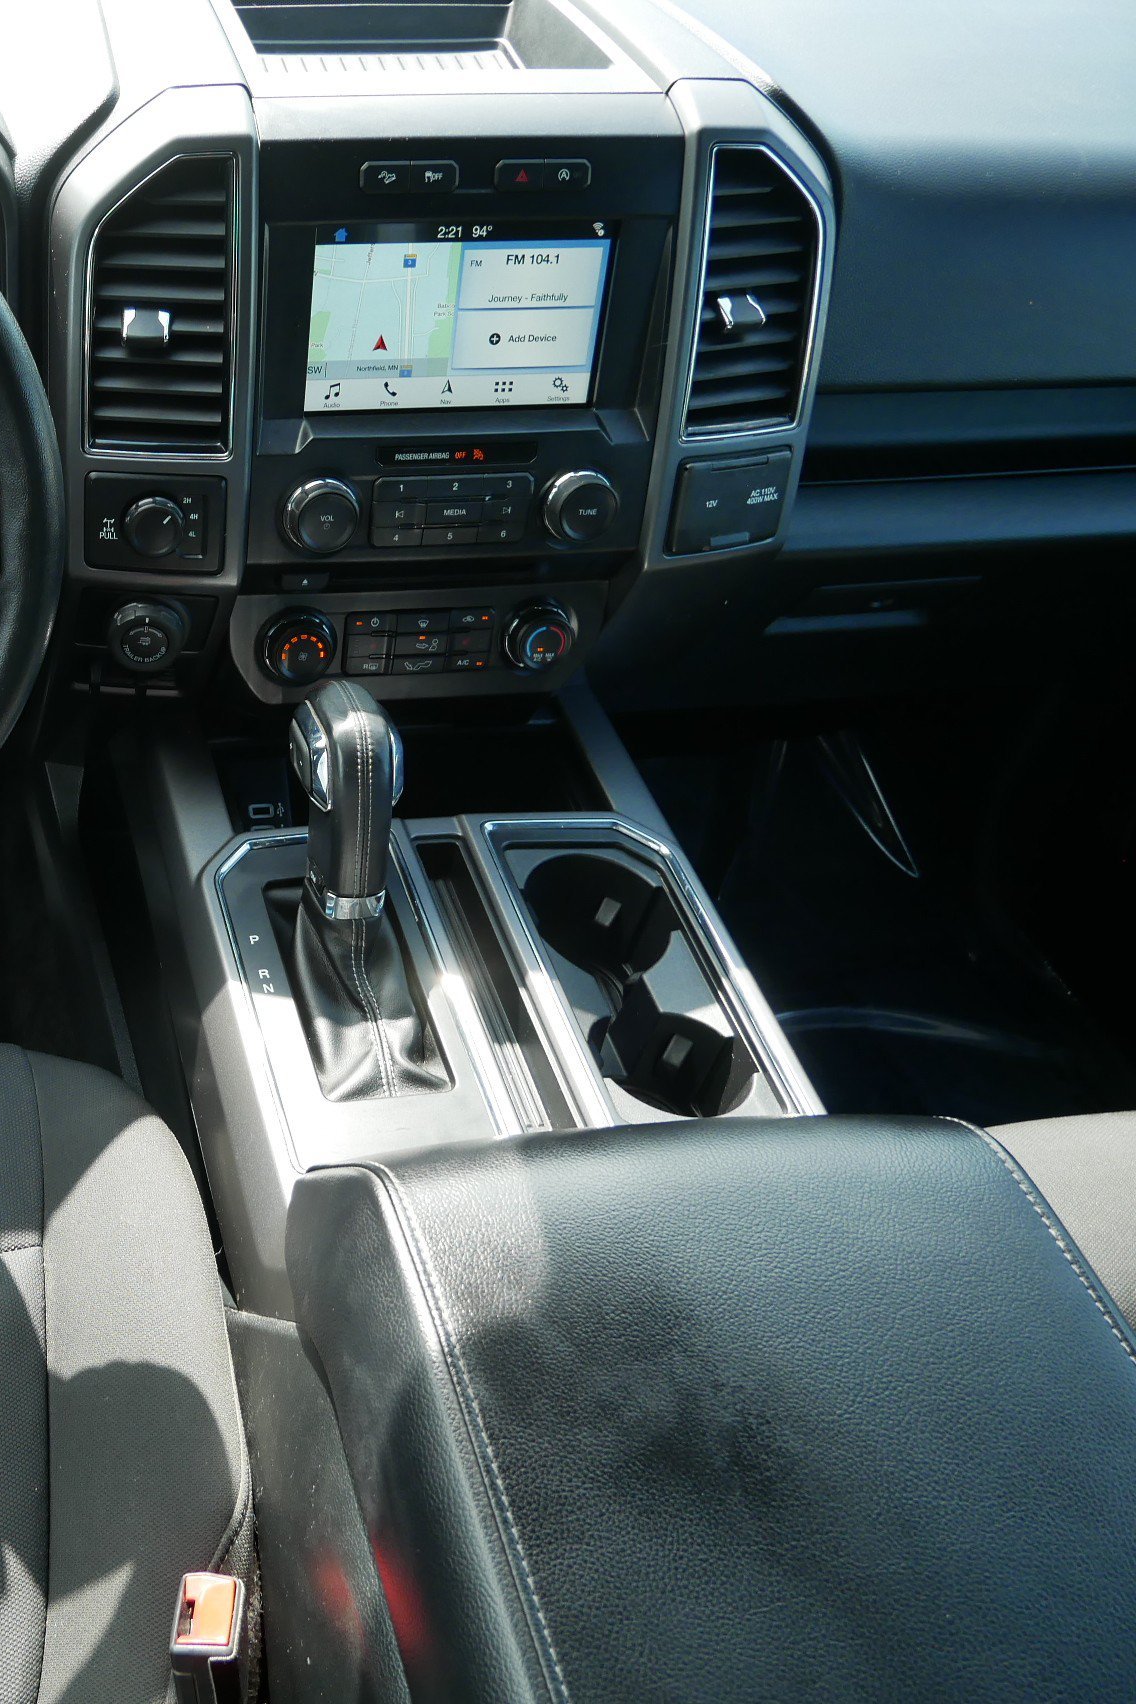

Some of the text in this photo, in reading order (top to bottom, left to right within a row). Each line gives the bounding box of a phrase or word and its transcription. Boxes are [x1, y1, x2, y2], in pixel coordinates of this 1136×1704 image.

[437, 226, 463, 238] 2:21
[470, 259, 483, 267] FM
[506, 253, 561, 265] FM 104.1
[488, 294, 523, 303] Journey
[530, 293, 569, 303] Faithfully
[508, 334, 557, 343] Add Device
[307, 366, 323, 375] SW
[394, 452, 450, 461] PASSENGER AIRBAG
[455, 451, 467, 459] OFF
[452, 483, 459, 491] 2
[506, 481, 512, 489] 3
[750, 487, 776, 497] AC 110V
[746, 493, 779, 505] 400W MAX
[705, 500, 718, 508] 12V
[443, 508, 467, 516] MEDIA
[578, 508, 598, 516] TUNE
[320, 514, 334, 522] VOL
[99, 531, 118, 540] PULL
[393, 534, 399, 542] 4
[447, 532, 453, 540] 5
[500, 530, 507, 538] 6
[249, 935, 259, 945] P
[258, 969, 270, 979] R
[263, 983, 275, 994] N
